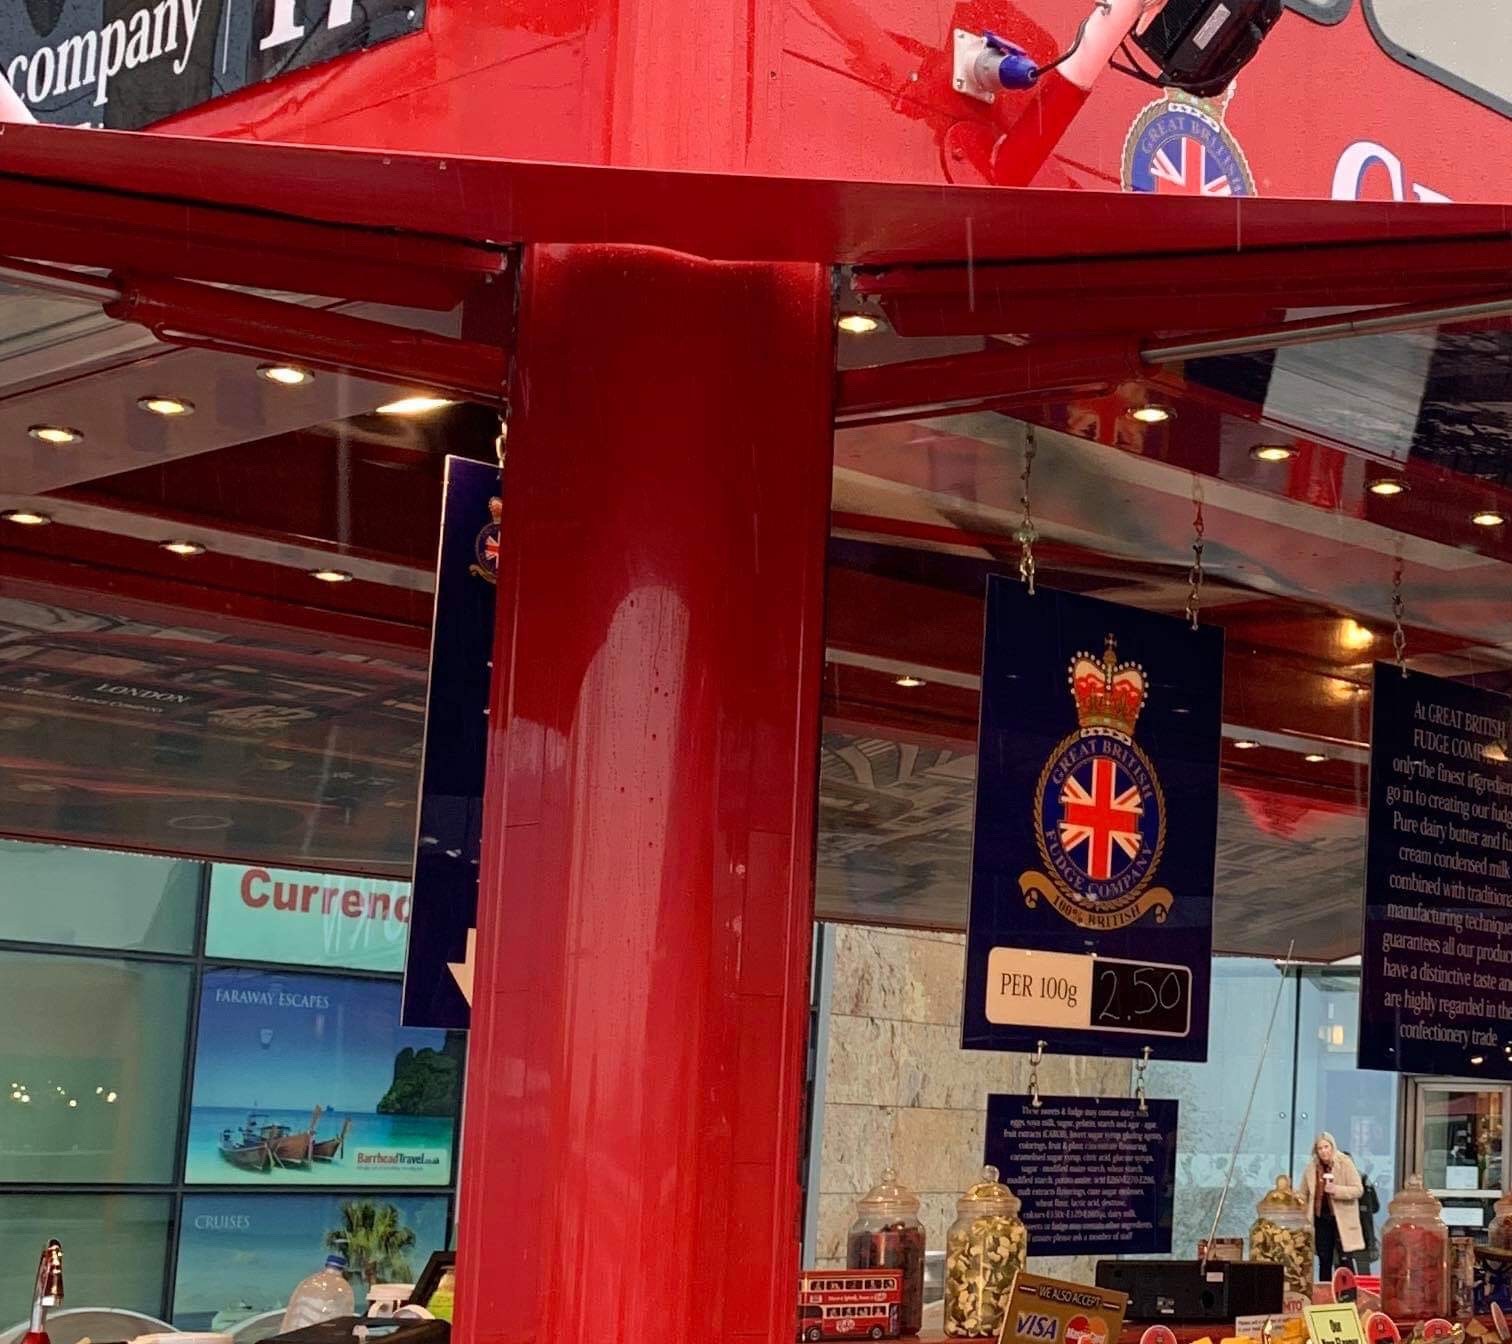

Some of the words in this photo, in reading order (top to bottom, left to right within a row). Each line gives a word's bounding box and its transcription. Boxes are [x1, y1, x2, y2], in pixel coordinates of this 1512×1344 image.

[1142, 117, 1185, 154] GREAT
[94, 682, 192, 703] LONDON
[1428, 704, 1464, 729] GREAT
[1465, 713, 1506, 738] BRITISH
[1414, 728, 1450, 755] FUDGE
[1052, 739, 1098, 785] GREAT
[1103, 740, 1154, 798] BRITISH
[1392, 755, 1416, 781] only
[1419, 760, 1435, 780] the
[1438, 762, 1465, 786] finest
[1386, 786, 1400, 806] go
[1402, 785, 1414, 804] in
[1415, 788, 1426, 807] to
[1428, 795, 1471, 821] creating
[1471, 803, 1489, 819] our
[1393, 810, 1419, 834] Pure
[1420, 817, 1446, 844] dairy
[1448, 821, 1480, 846] butter
[1481, 832, 1500, 850] and
[1045, 830, 1083, 891] FUDGE
[1087, 841, 1152, 899] COMPANY
[1399, 846, 1432, 865] cream
[1433, 851, 1488, 875] condensed
[1489, 859, 1511, 879] milk
[1389, 871, 1440, 896] combined
[1442, 880, 1466, 899] with
[1088, 905, 1142, 928] BRITISH
[1387, 902, 1463, 934] manufacturing
[1382, 932, 1441, 954] guarantees
[1442, 935, 1456, 955] all
[1456, 943, 1474, 958] our
[1383, 956, 1409, 979] have
[1410, 965, 1418, 979] a
[1419, 961, 1472, 986] distinctive
[1473, 971, 1497, 990] taste
[216, 988, 275, 1006] FARAWAY
[279, 992, 330, 1009] ESCAPES
[1000, 972, 1033, 998] PER
[1039, 977, 1078, 1008] 100g
[1099, 967, 1181, 1021] 2.50
[1384, 991, 1402, 1007] are
[1403, 988, 1437, 1017] highly
[1439, 996, 1485, 1019] regarded
[1485, 999, 1497, 1018] in
[1400, 1020, 1470, 1050] confectionery
[1471, 1027, 1498, 1047] trade
[194, 1214, 250, 1230] CRUISES
[1040, 1286, 1055, 1298] WE
[1053, 1289, 1073, 1302] ALSO
[1072, 1293, 1101, 1307] ACCEPT
[1017, 1314, 1058, 1340] VISA
[1329, 1319, 1342, 1333] Our
